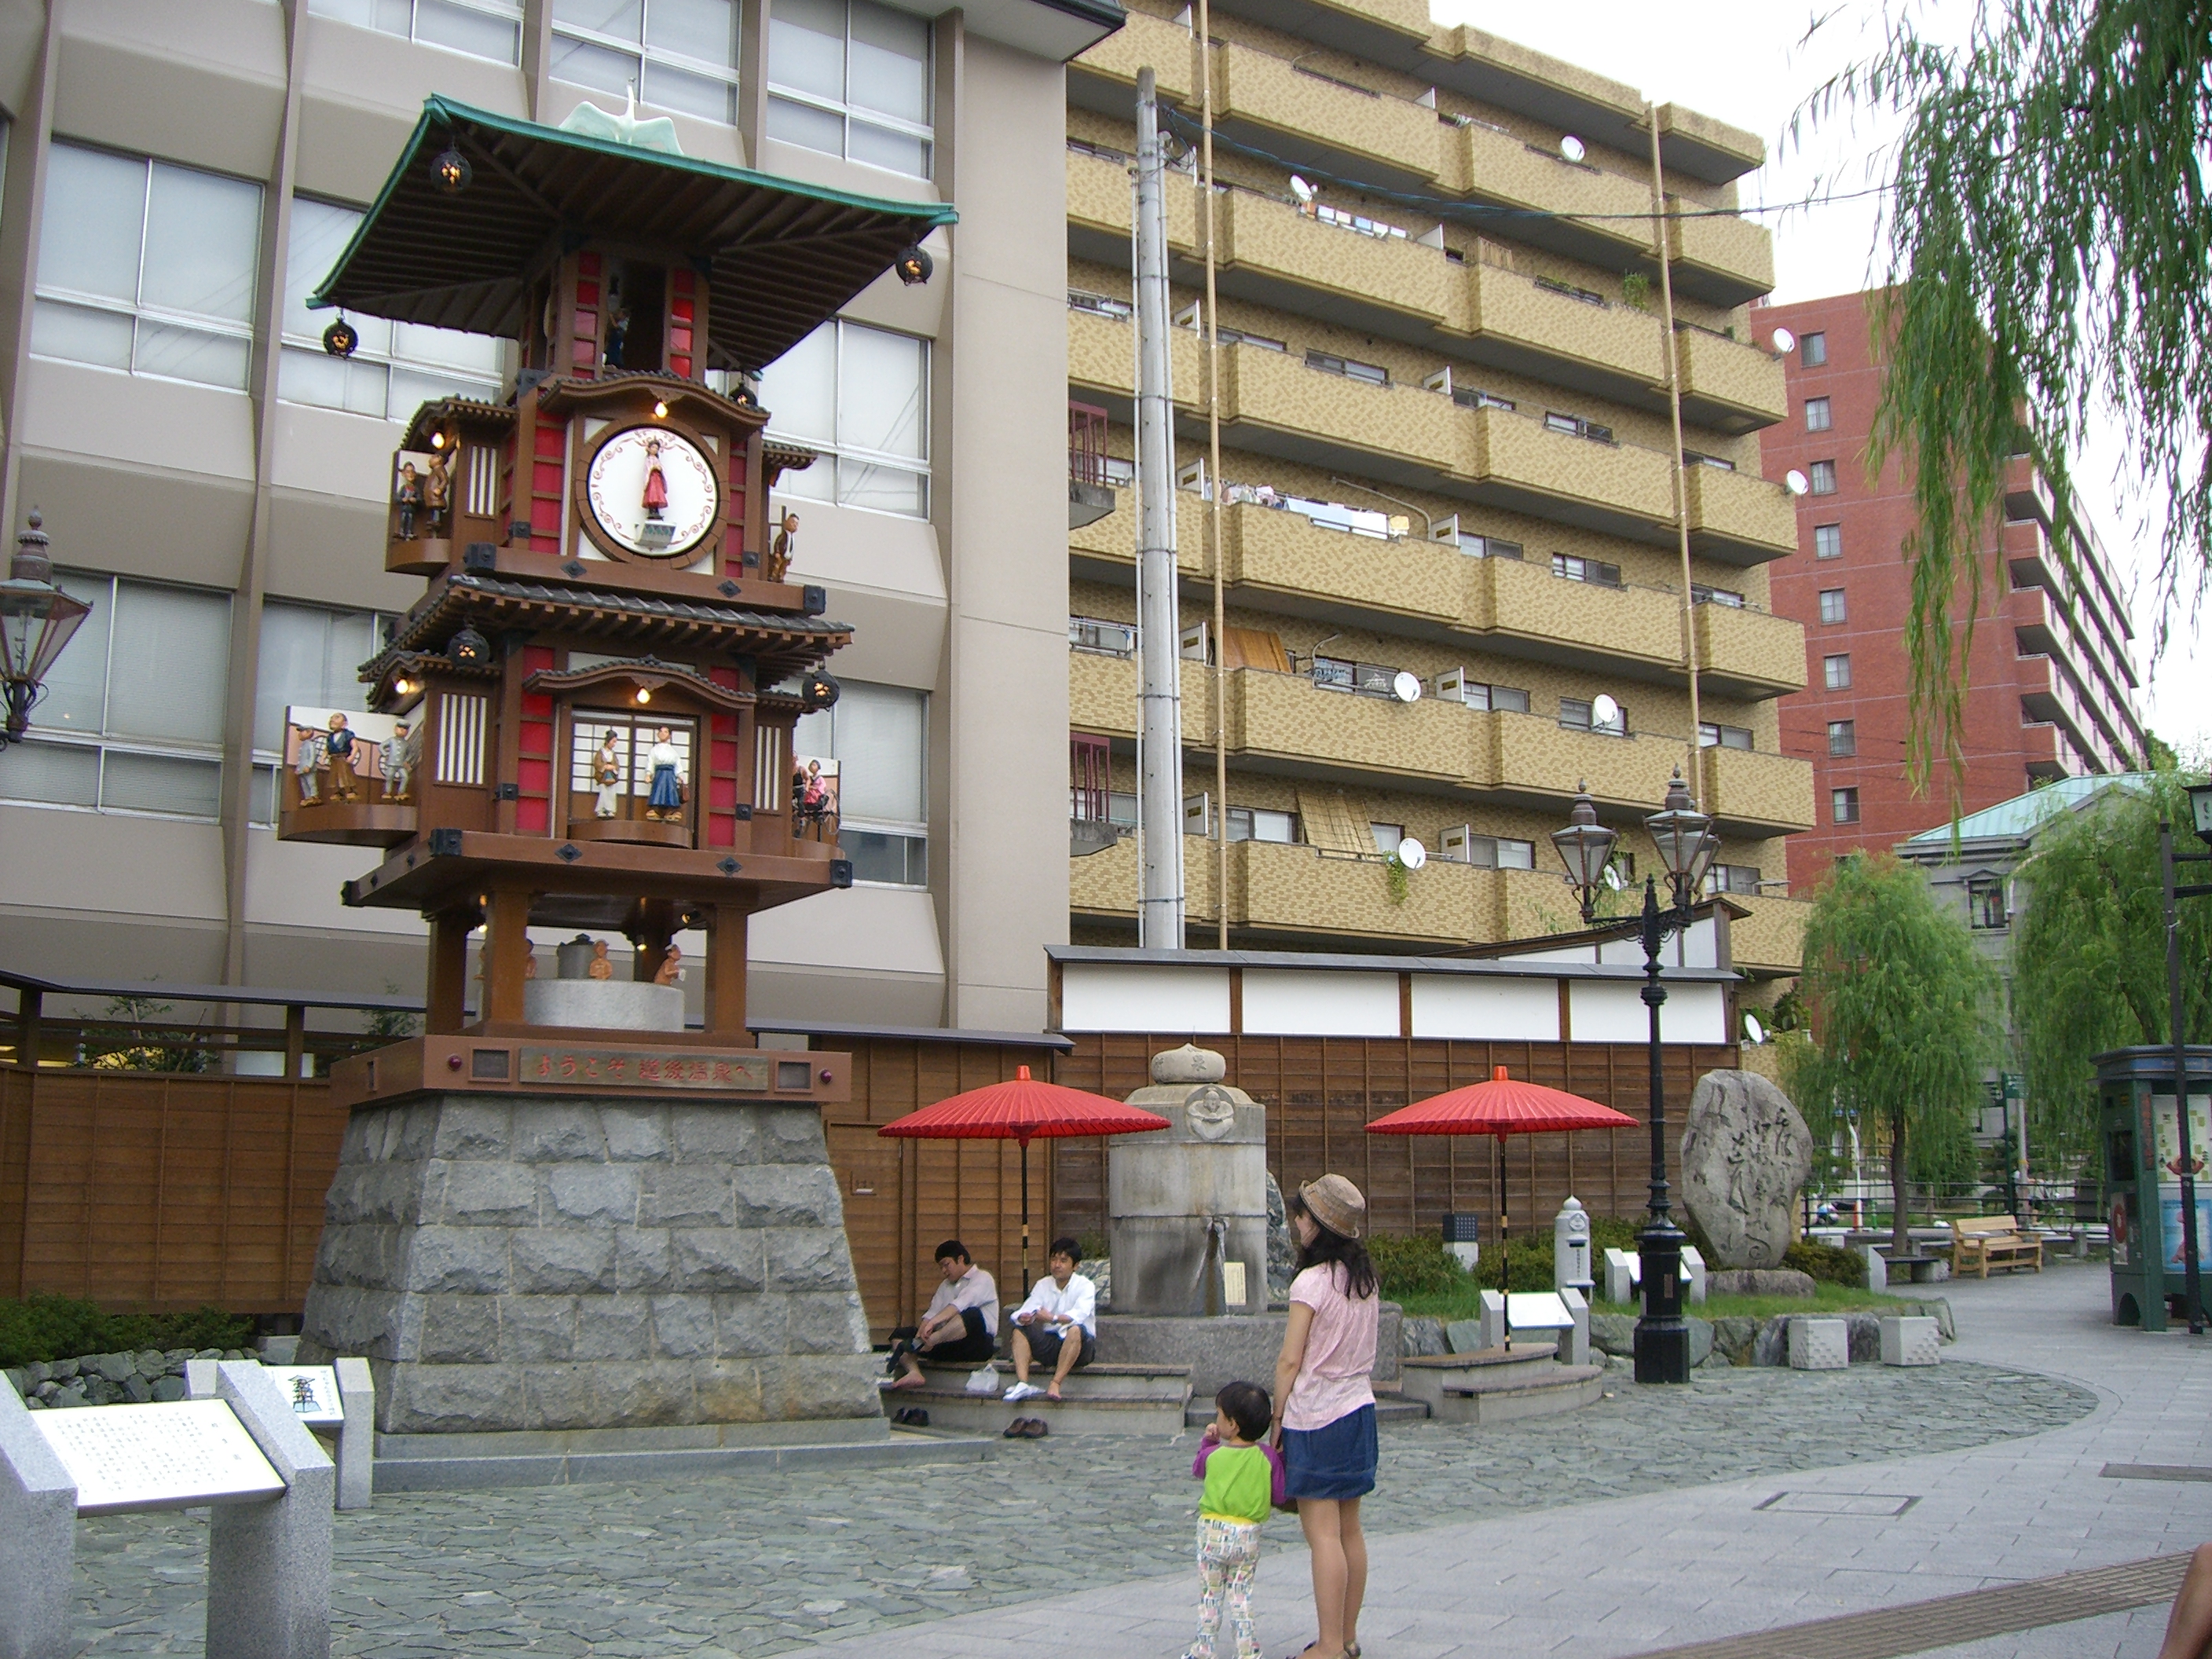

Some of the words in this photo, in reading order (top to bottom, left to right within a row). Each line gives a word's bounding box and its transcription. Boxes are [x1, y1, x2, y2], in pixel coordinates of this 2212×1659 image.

[536, 1054, 626, 1080] ようこそ
[638, 1057, 754, 1083] 道後温泉へ
